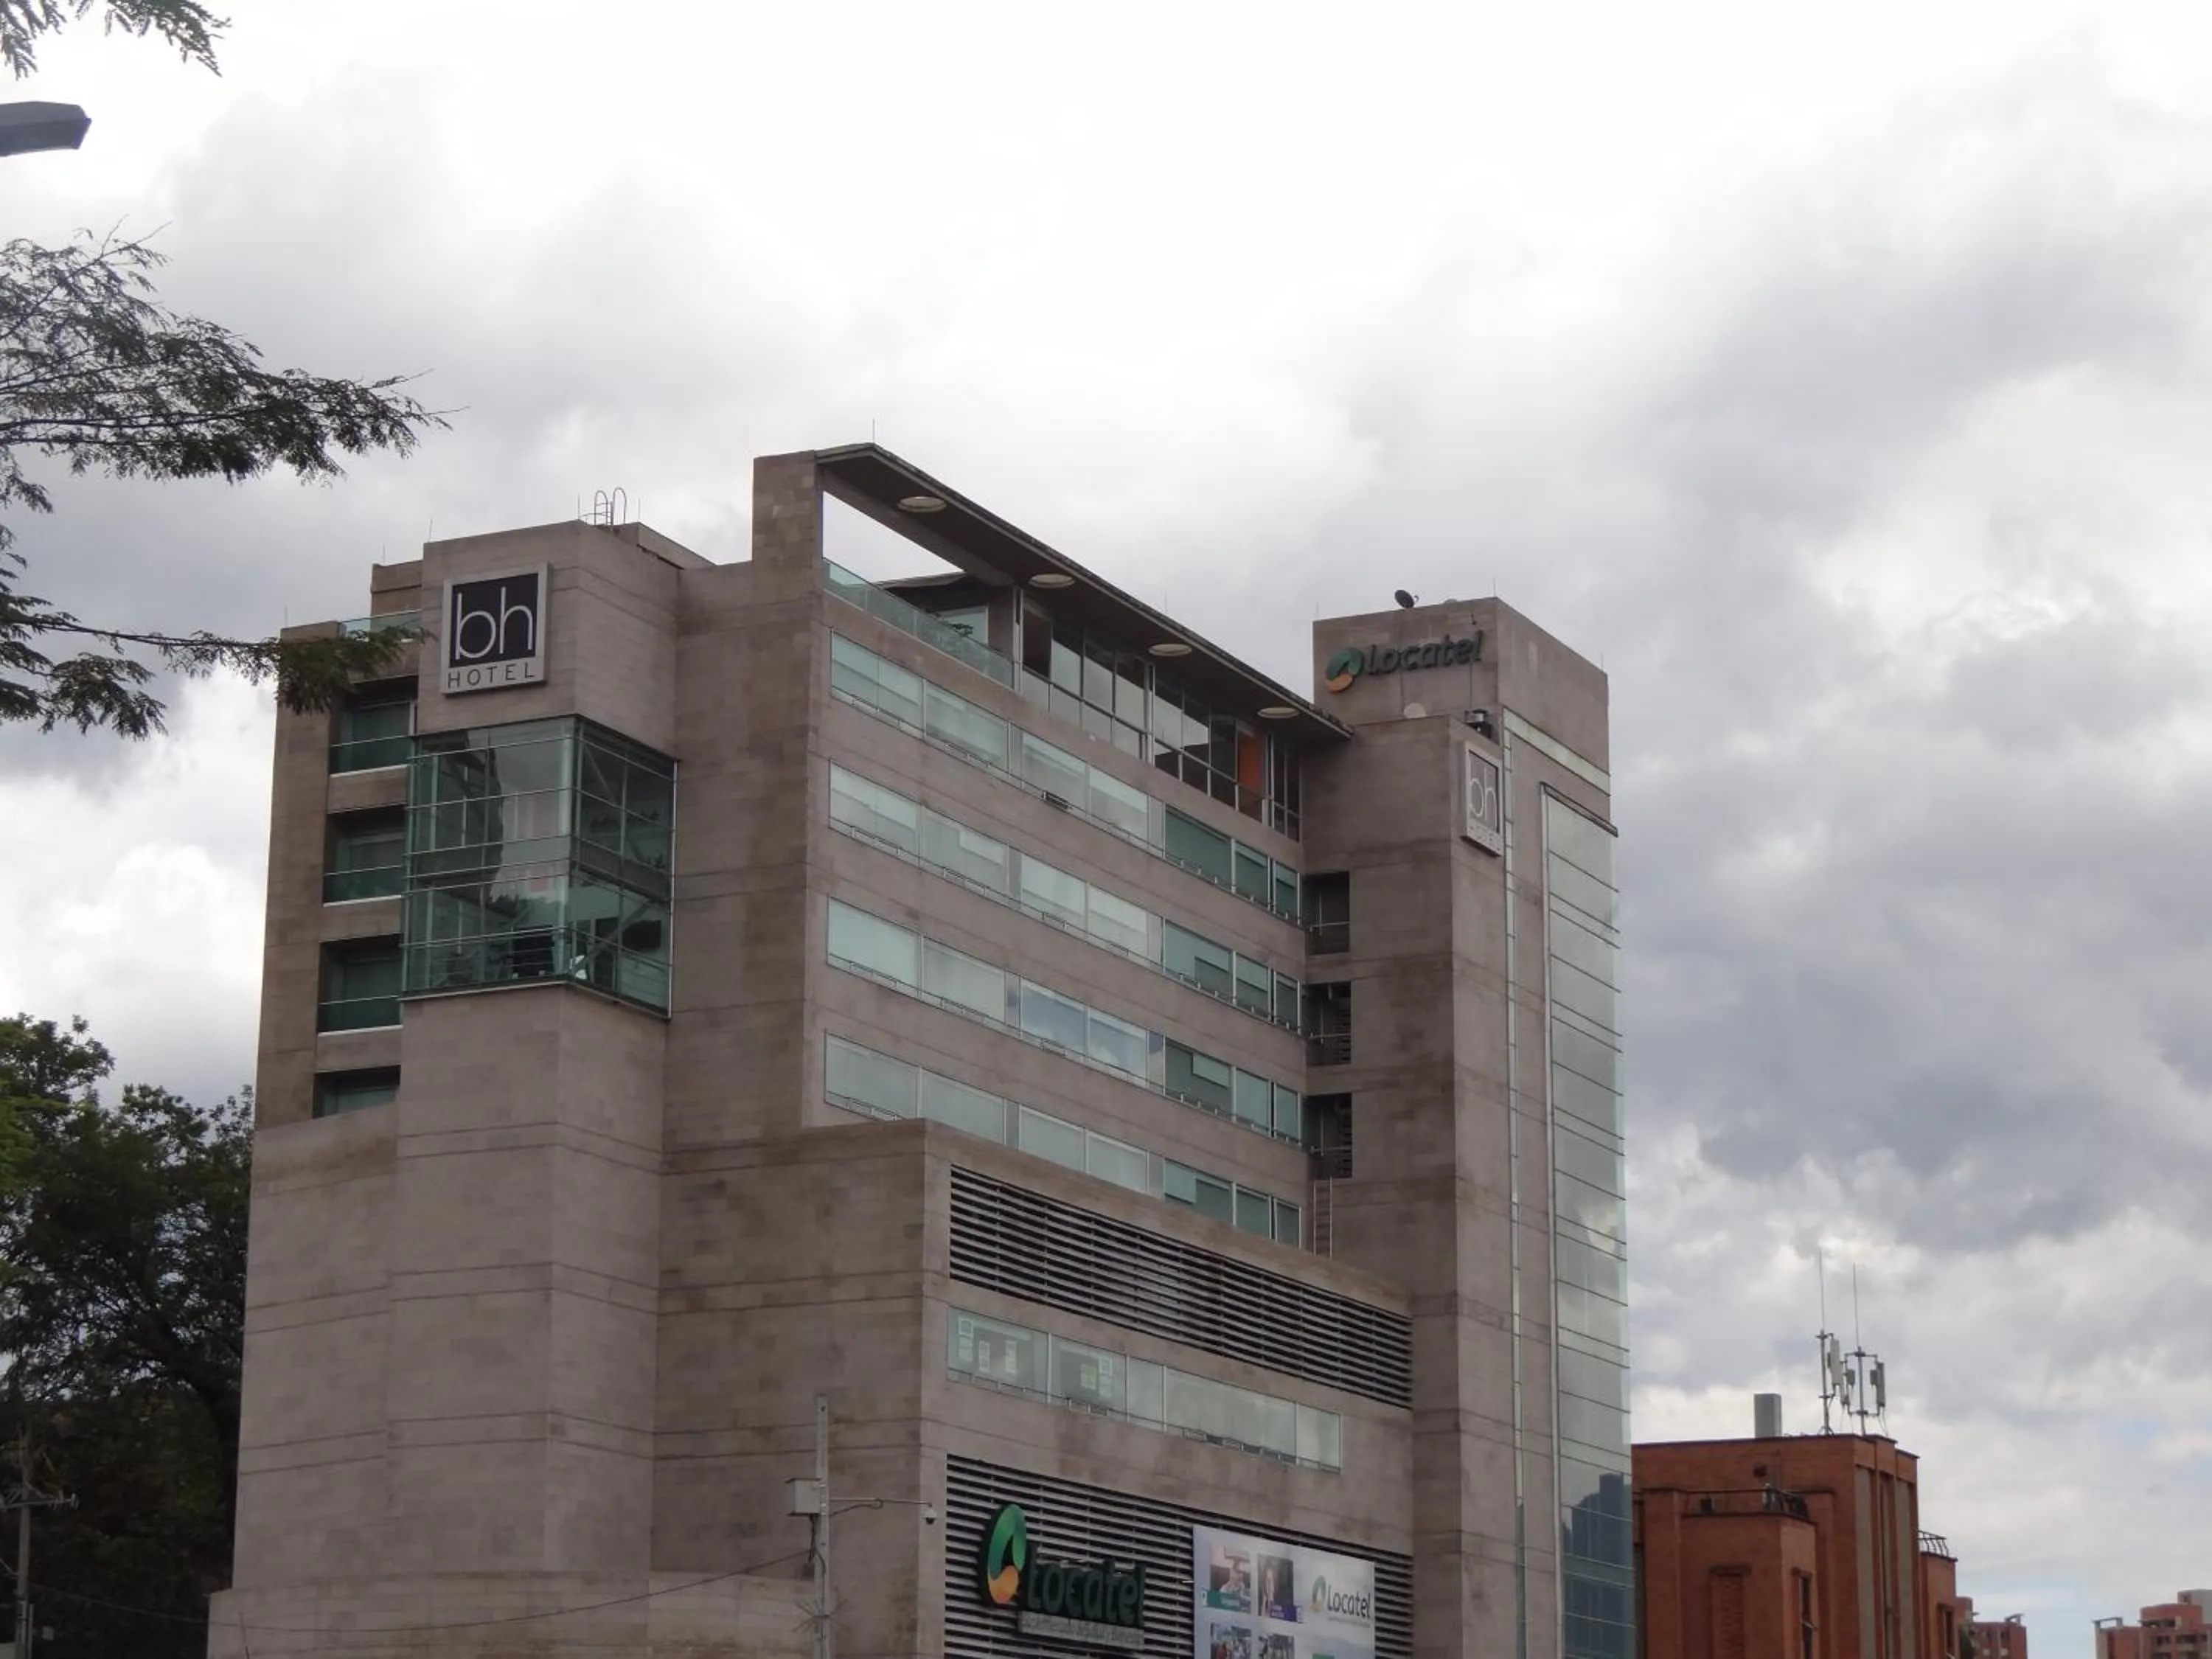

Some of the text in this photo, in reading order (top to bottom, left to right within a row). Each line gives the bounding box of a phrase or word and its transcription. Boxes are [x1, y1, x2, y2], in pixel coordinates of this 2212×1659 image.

[455, 586, 533, 660] bh
[1367, 630, 1485, 675] Locatel
[448, 662, 535, 689] HOTEL
[1028, 1541, 1147, 1627] Locatel
[1327, 1585, 1371, 1618] Locatel
